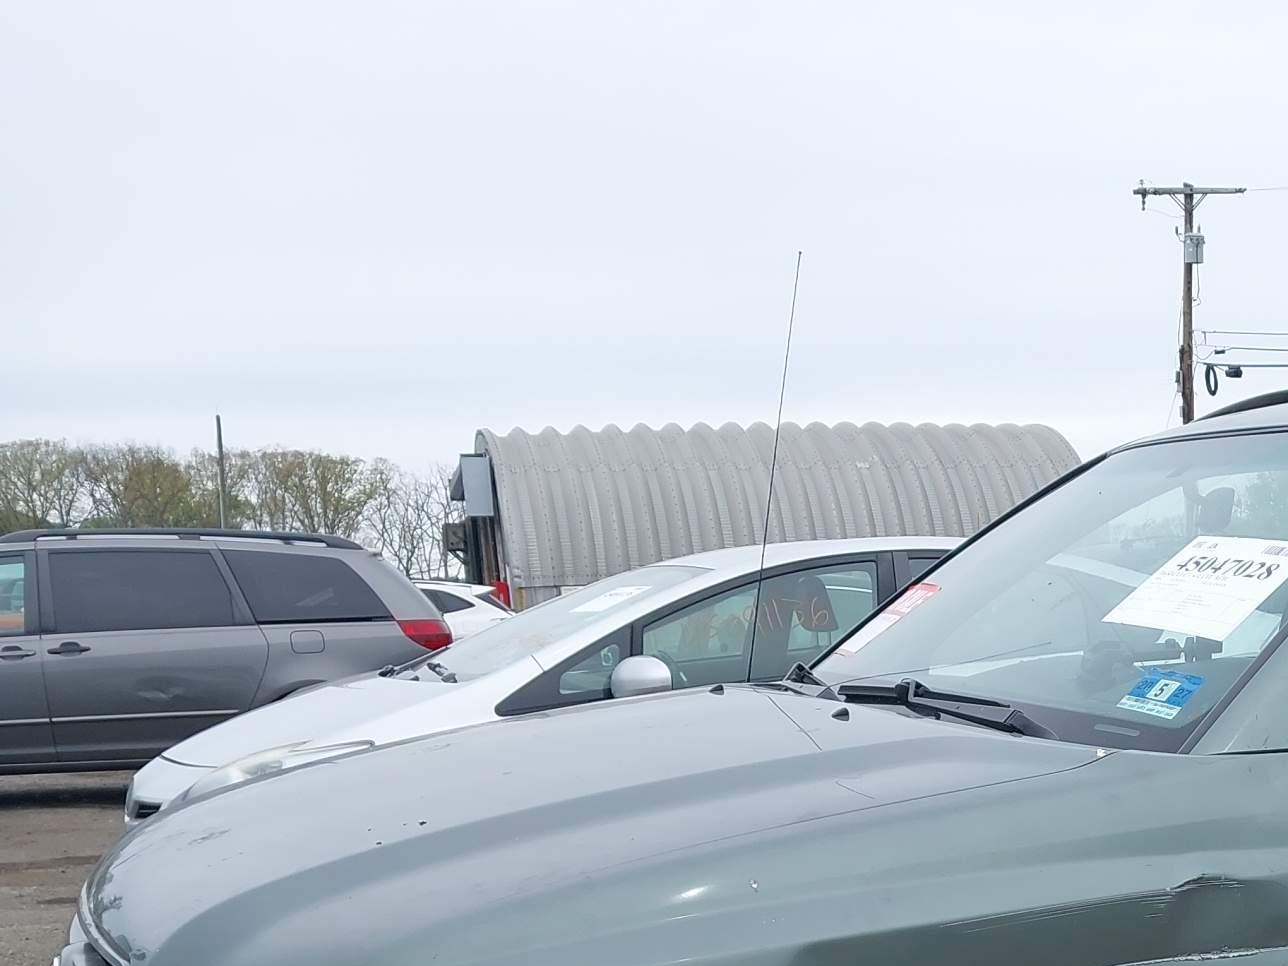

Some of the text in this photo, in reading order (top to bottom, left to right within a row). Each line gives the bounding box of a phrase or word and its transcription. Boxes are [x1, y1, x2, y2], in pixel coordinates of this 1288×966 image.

[1177, 555, 1281, 581] 45047028
[1154, 683, 1169, 697] 5
[1173, 688, 1192, 699] 27
